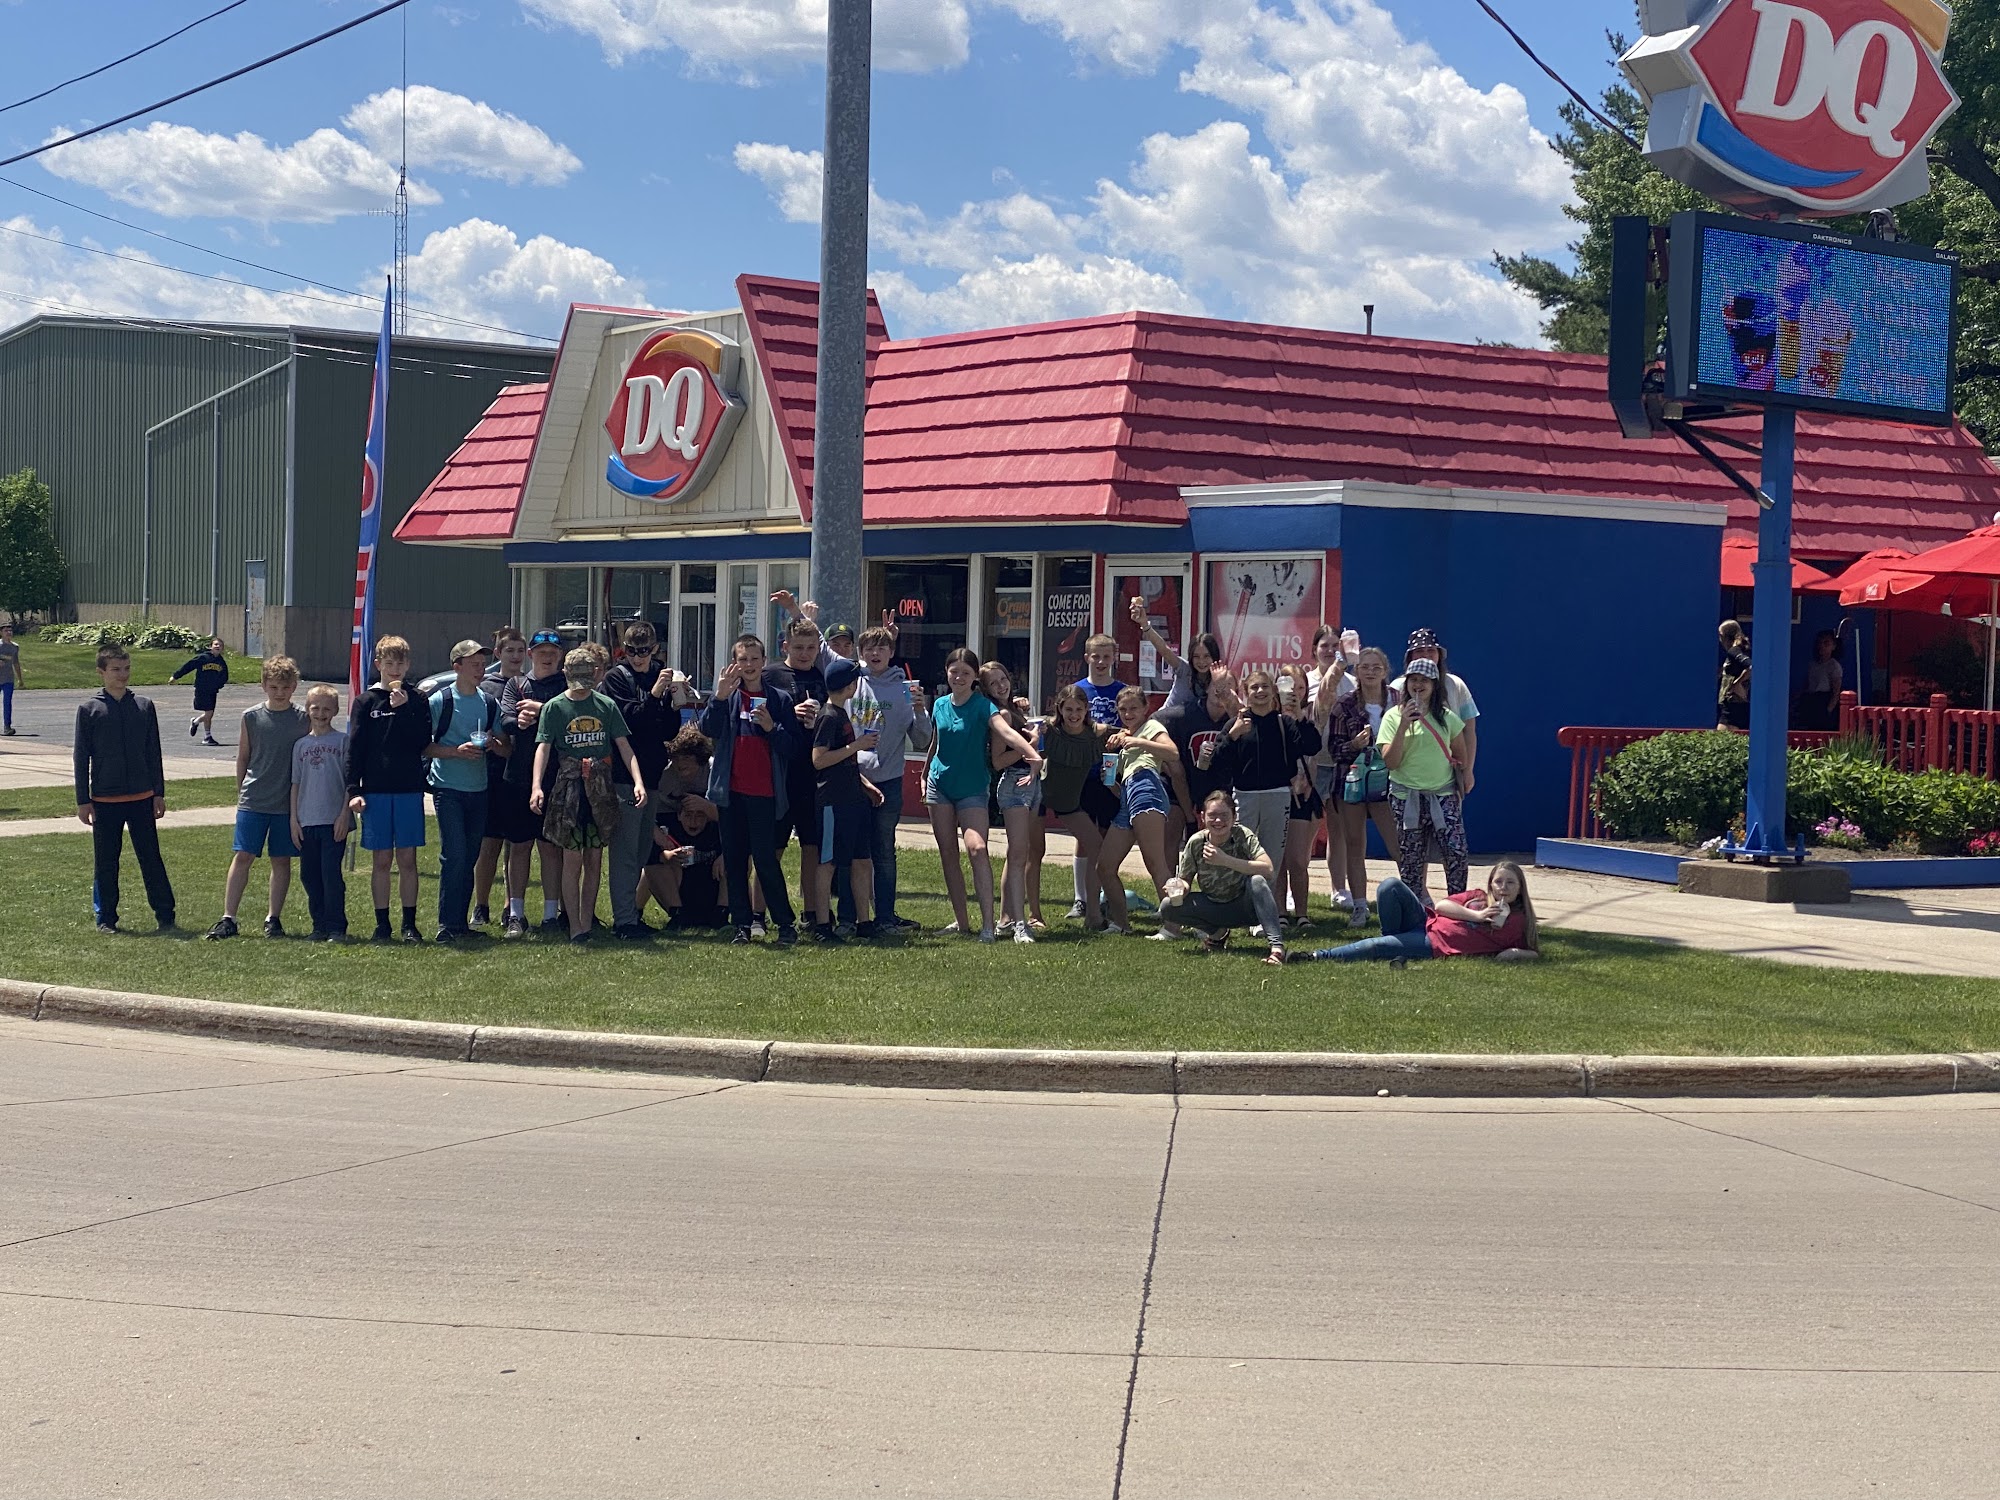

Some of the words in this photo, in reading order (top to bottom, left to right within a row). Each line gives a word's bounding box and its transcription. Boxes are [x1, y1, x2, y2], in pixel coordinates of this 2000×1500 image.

[1735, 0, 1918, 158] DQ
[1812, 233, 1852, 245] DAKTRONICS
[1935, 252, 1959, 262] GALAXY
[621, 367, 705, 460] DQ
[899, 599, 924, 616] OPEN
[1048, 594, 1071, 610] COME
[1072, 594, 1091, 610] FOR
[1047, 611, 1090, 627] DESSERT
[1266, 635, 1303, 660] IT'S
[1056, 660, 1082, 675] STAY
[564, 732, 606, 744] EDGAR
